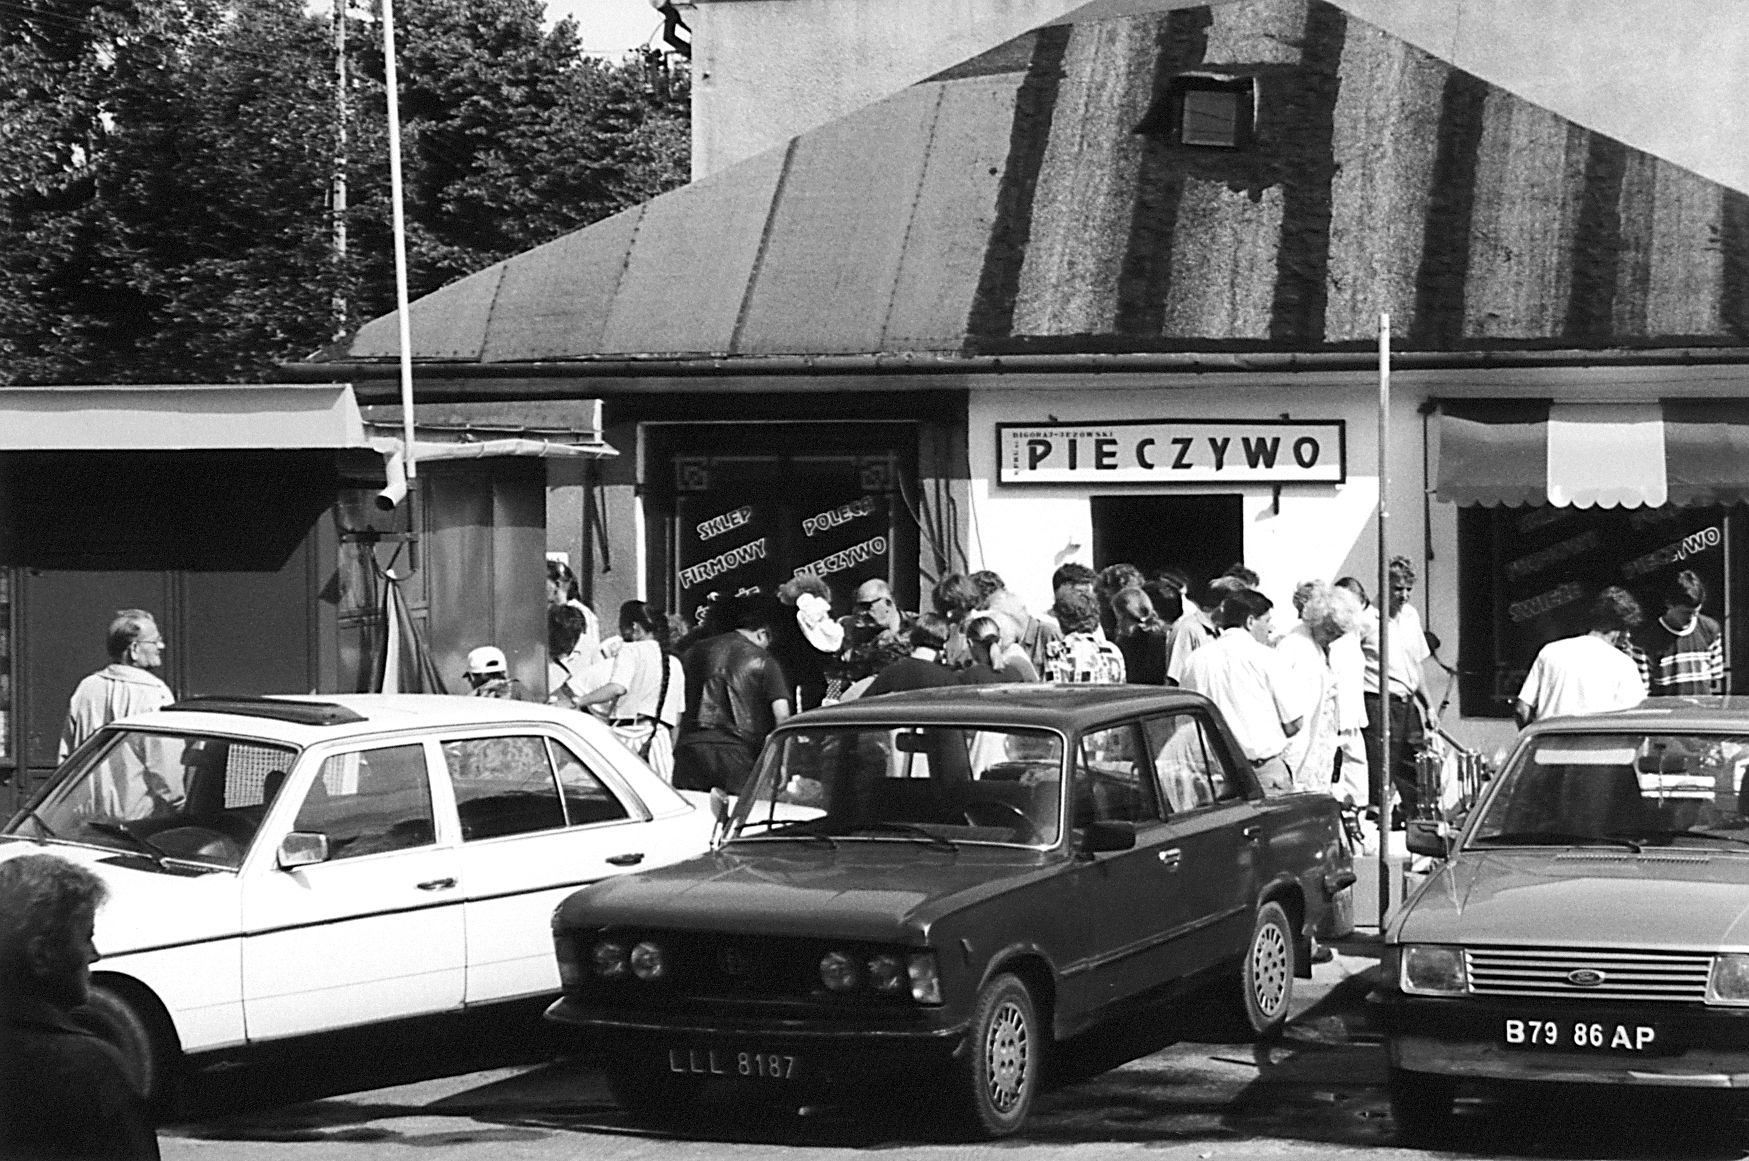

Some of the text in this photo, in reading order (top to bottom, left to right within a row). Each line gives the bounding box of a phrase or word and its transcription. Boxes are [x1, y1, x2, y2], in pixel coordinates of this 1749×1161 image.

[1026, 436, 1321, 471] PIECZYWO
[696, 505, 752, 541] SKLEP
[679, 538, 767, 589] FIRMOWY
[669, 1050, 794, 1079] LLL 8187
